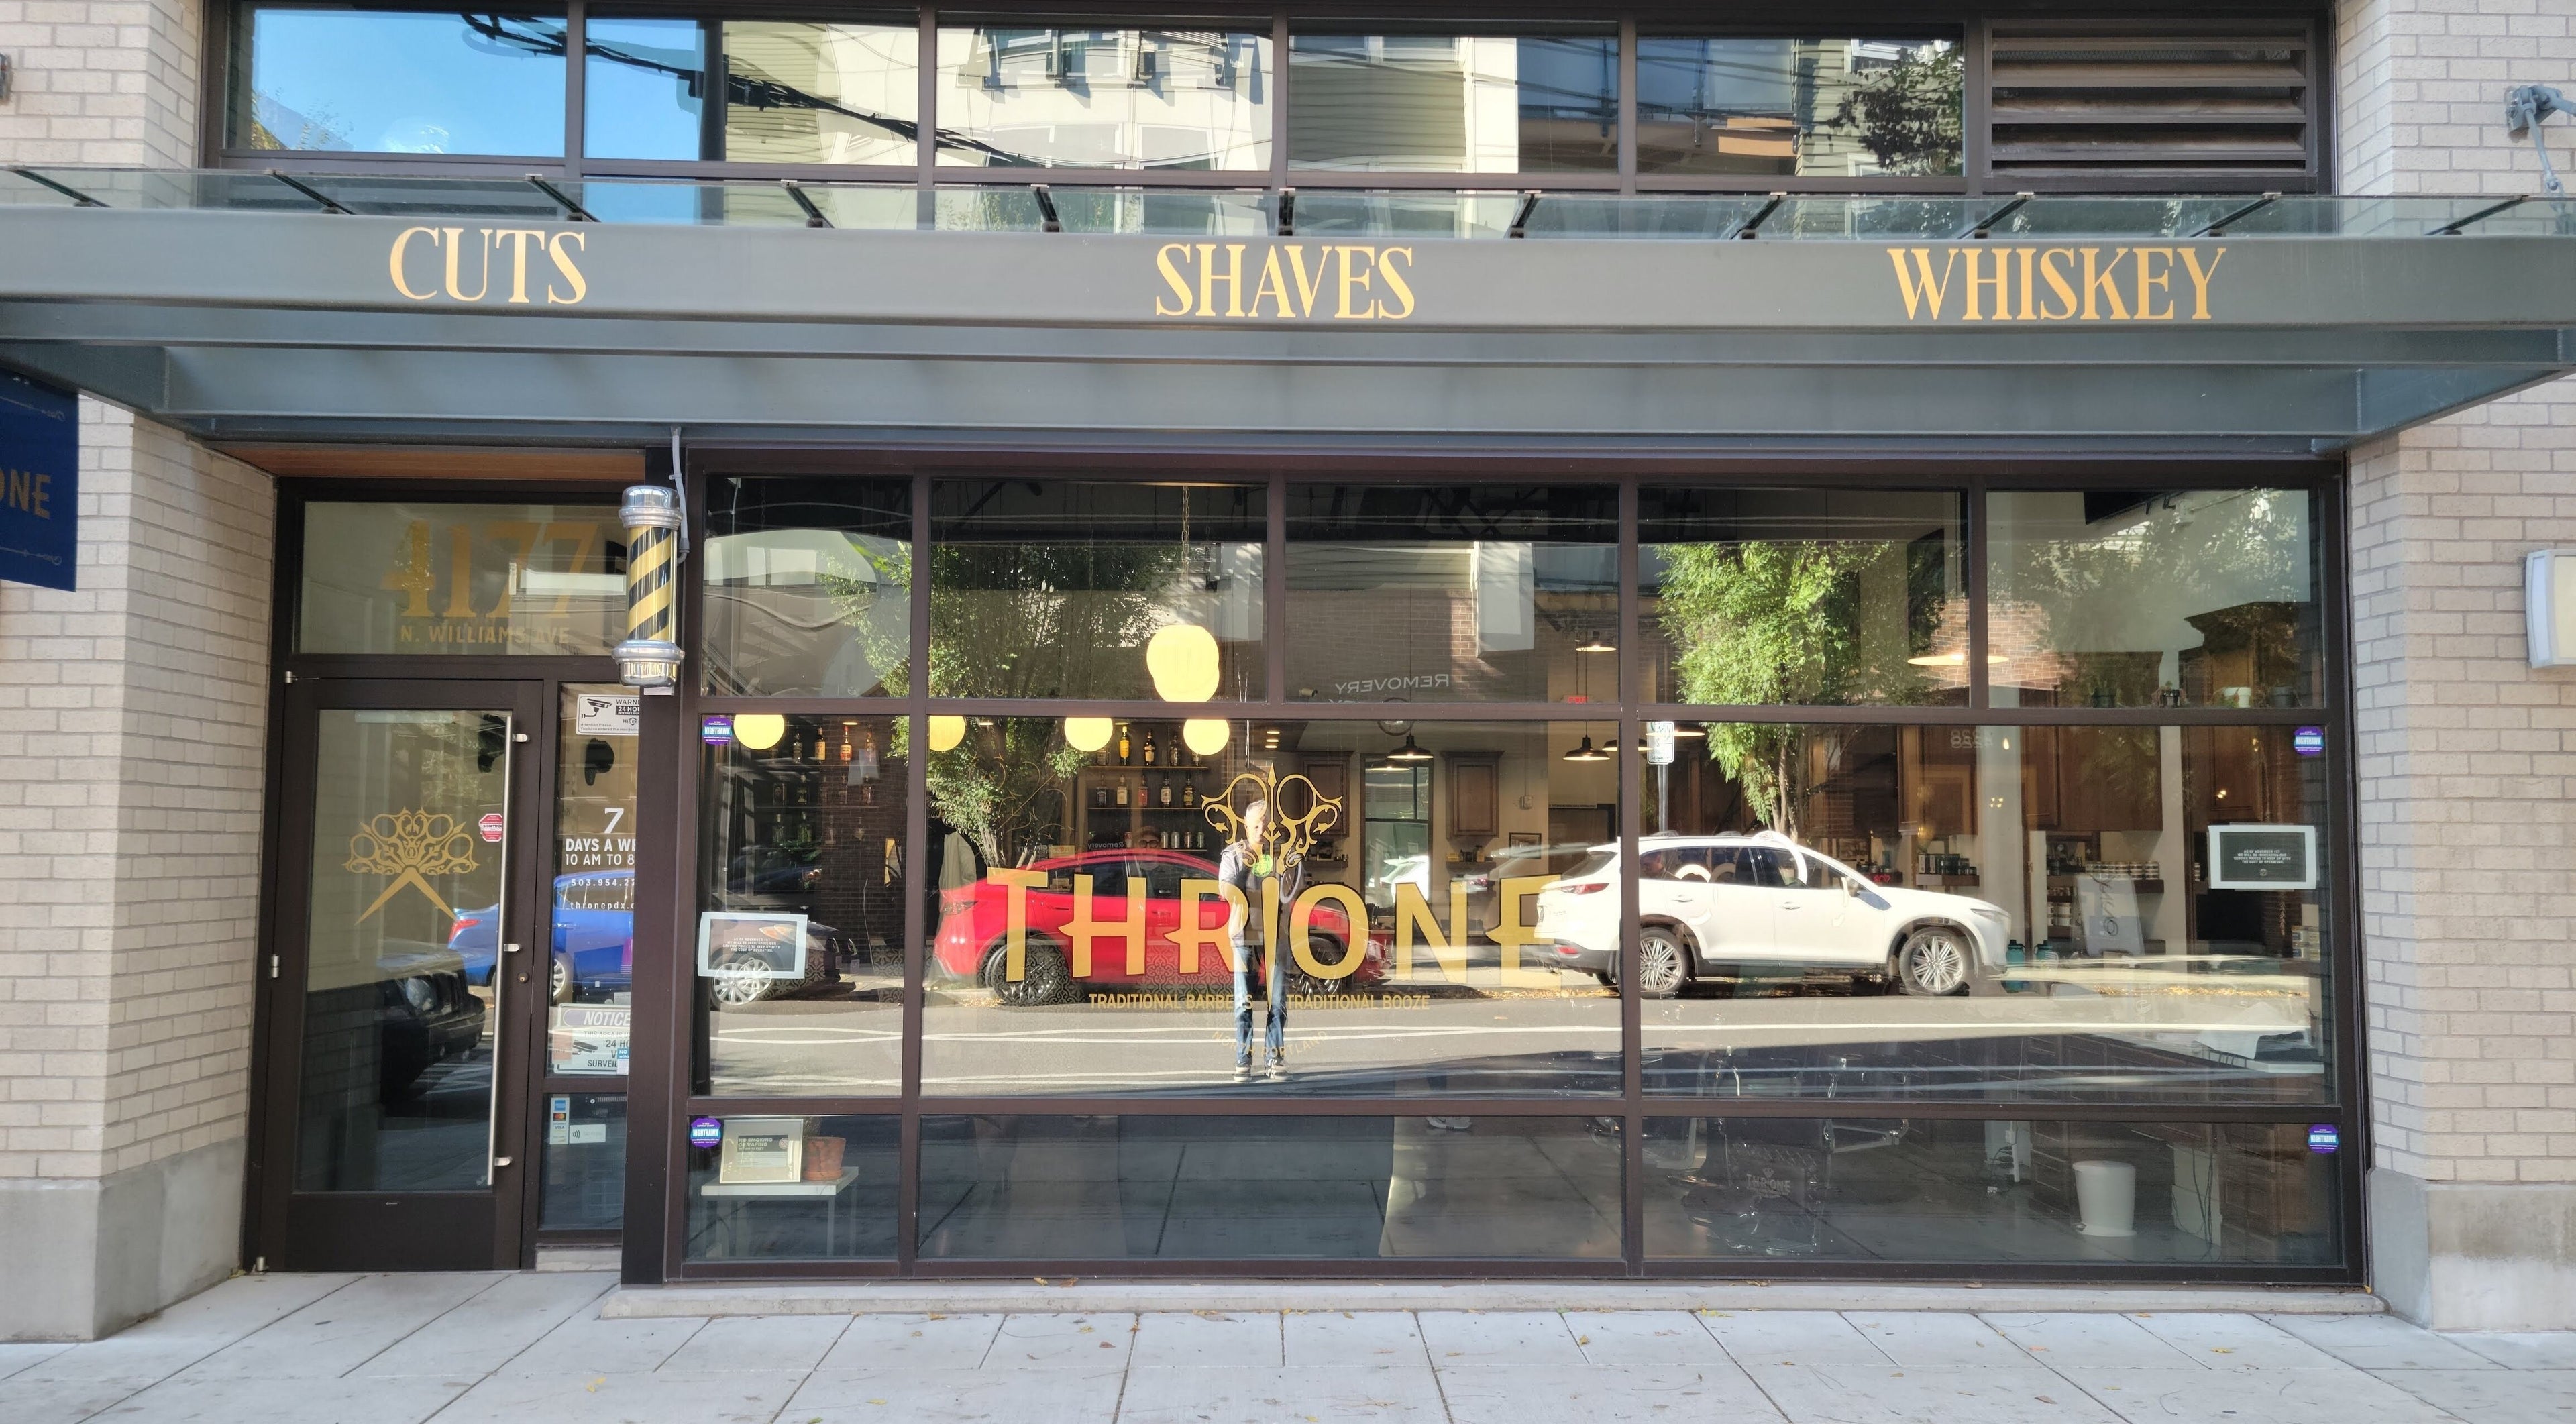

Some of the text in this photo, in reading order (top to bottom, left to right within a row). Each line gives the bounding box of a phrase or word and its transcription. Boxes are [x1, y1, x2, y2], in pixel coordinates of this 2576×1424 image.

[390, 227, 586, 304] CUTS
[1156, 243, 1415, 319] SHAVES
[1886, 247, 2226, 320] WHISKEY
[382, 519, 600, 618] 4177
[401, 626, 570, 644] N. WILLIAMS AVE
[604, 808, 624, 834] 7
[566, 839, 600, 852] DAYS
[604, 839, 613, 852] A
[566, 854, 635, 865] 10 AM TO 8
[1089, 993, 1253, 1010] TRADITIONAL BARBES
[1287, 994, 1430, 1011] TRADITIONAL BOOZE
[583, 1011, 631, 1026] NOTICE
[605, 1040, 616, 1048] 24
[1261, 1030, 1328, 1058] PORTLAND
[692, 1128, 719, 1137] NIGHTHAWK
